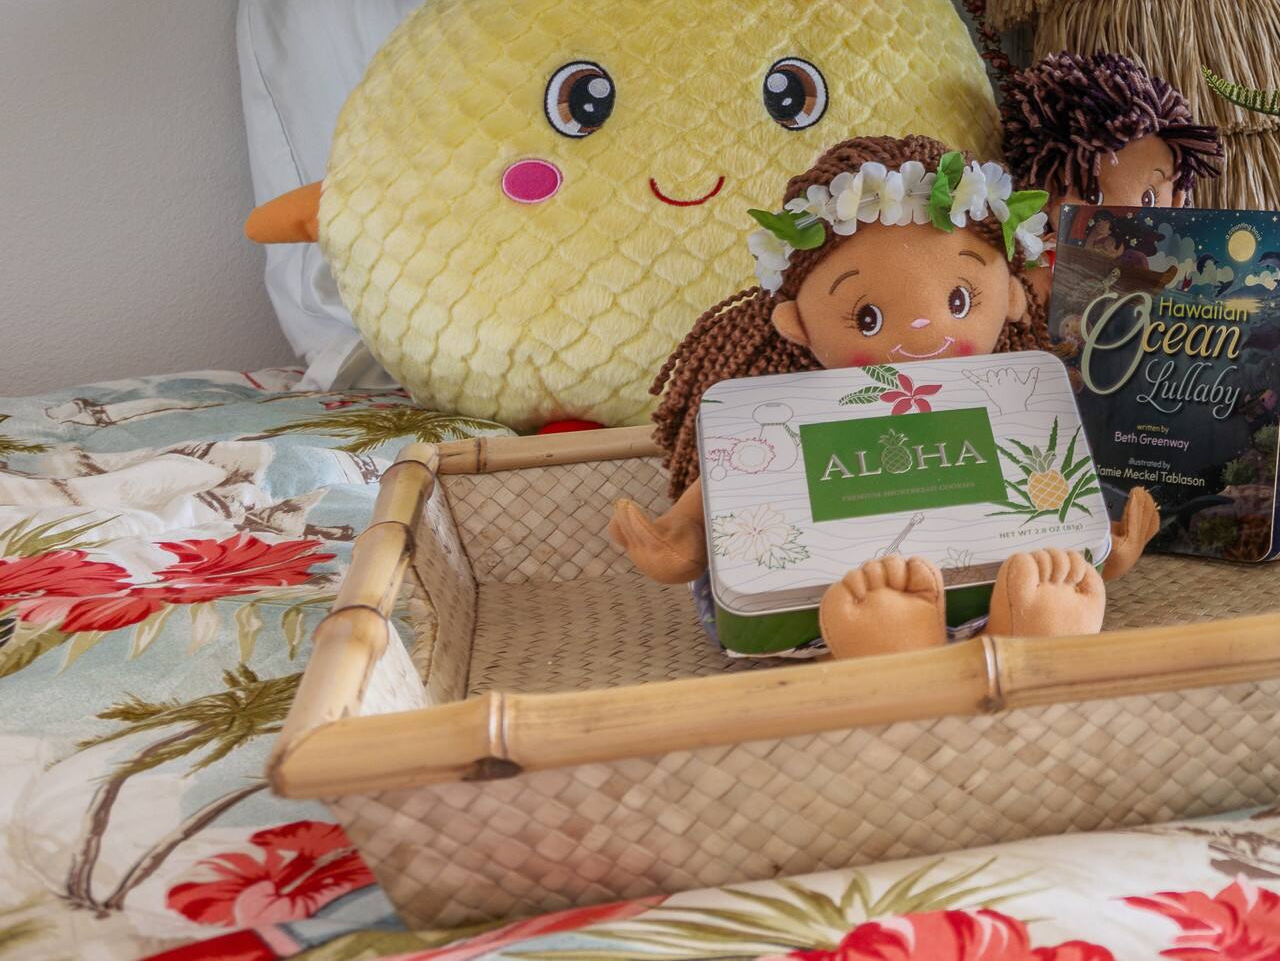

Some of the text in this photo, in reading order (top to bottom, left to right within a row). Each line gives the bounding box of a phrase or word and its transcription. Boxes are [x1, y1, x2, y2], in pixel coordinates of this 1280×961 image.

[1159, 296, 1248, 322] Hawaiian
[1080, 291, 1241, 394] Ocean
[1136, 358, 1241, 419] Lullaby
[1136, 424, 1169, 435] written by
[1114, 431, 1190, 452] Beth Greenway
[819, 428, 988, 481] ALOHA
[1128, 458, 1171, 470] illustrated by
[1123, 467, 1159, 481] Meckel
[1160, 471, 1206, 487] Tablason
[999, 531, 1016, 539] NET
[1048, 525, 1061, 533] OZ
